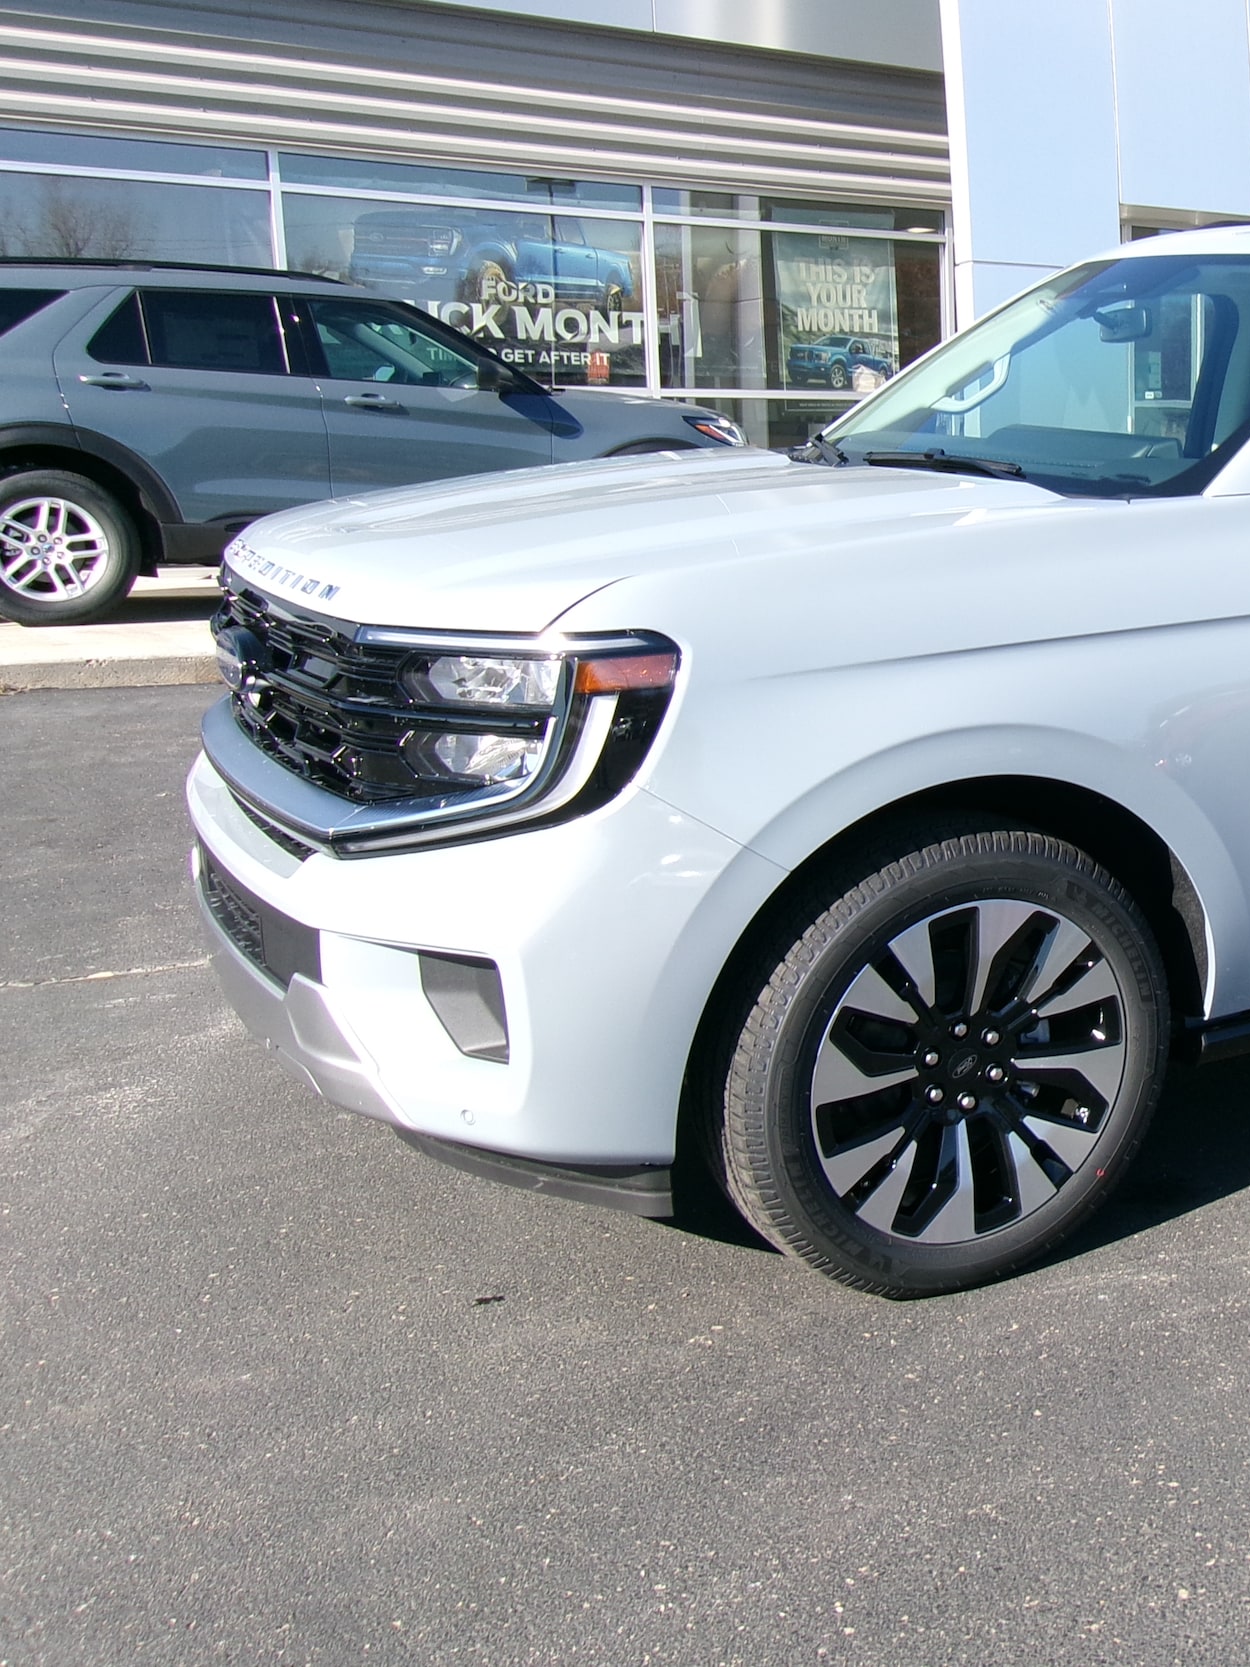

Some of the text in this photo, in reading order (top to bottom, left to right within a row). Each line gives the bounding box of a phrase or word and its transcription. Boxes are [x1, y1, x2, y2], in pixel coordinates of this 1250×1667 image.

[795, 257, 875, 284] THIS IS
[480, 280, 554, 304] FORD
[806, 283, 867, 308] YOUR
[797, 308, 878, 333] MONTH
[502, 349, 532, 363] GET
[539, 351, 591, 366] AFTER
[595, 353, 610, 366] IT
